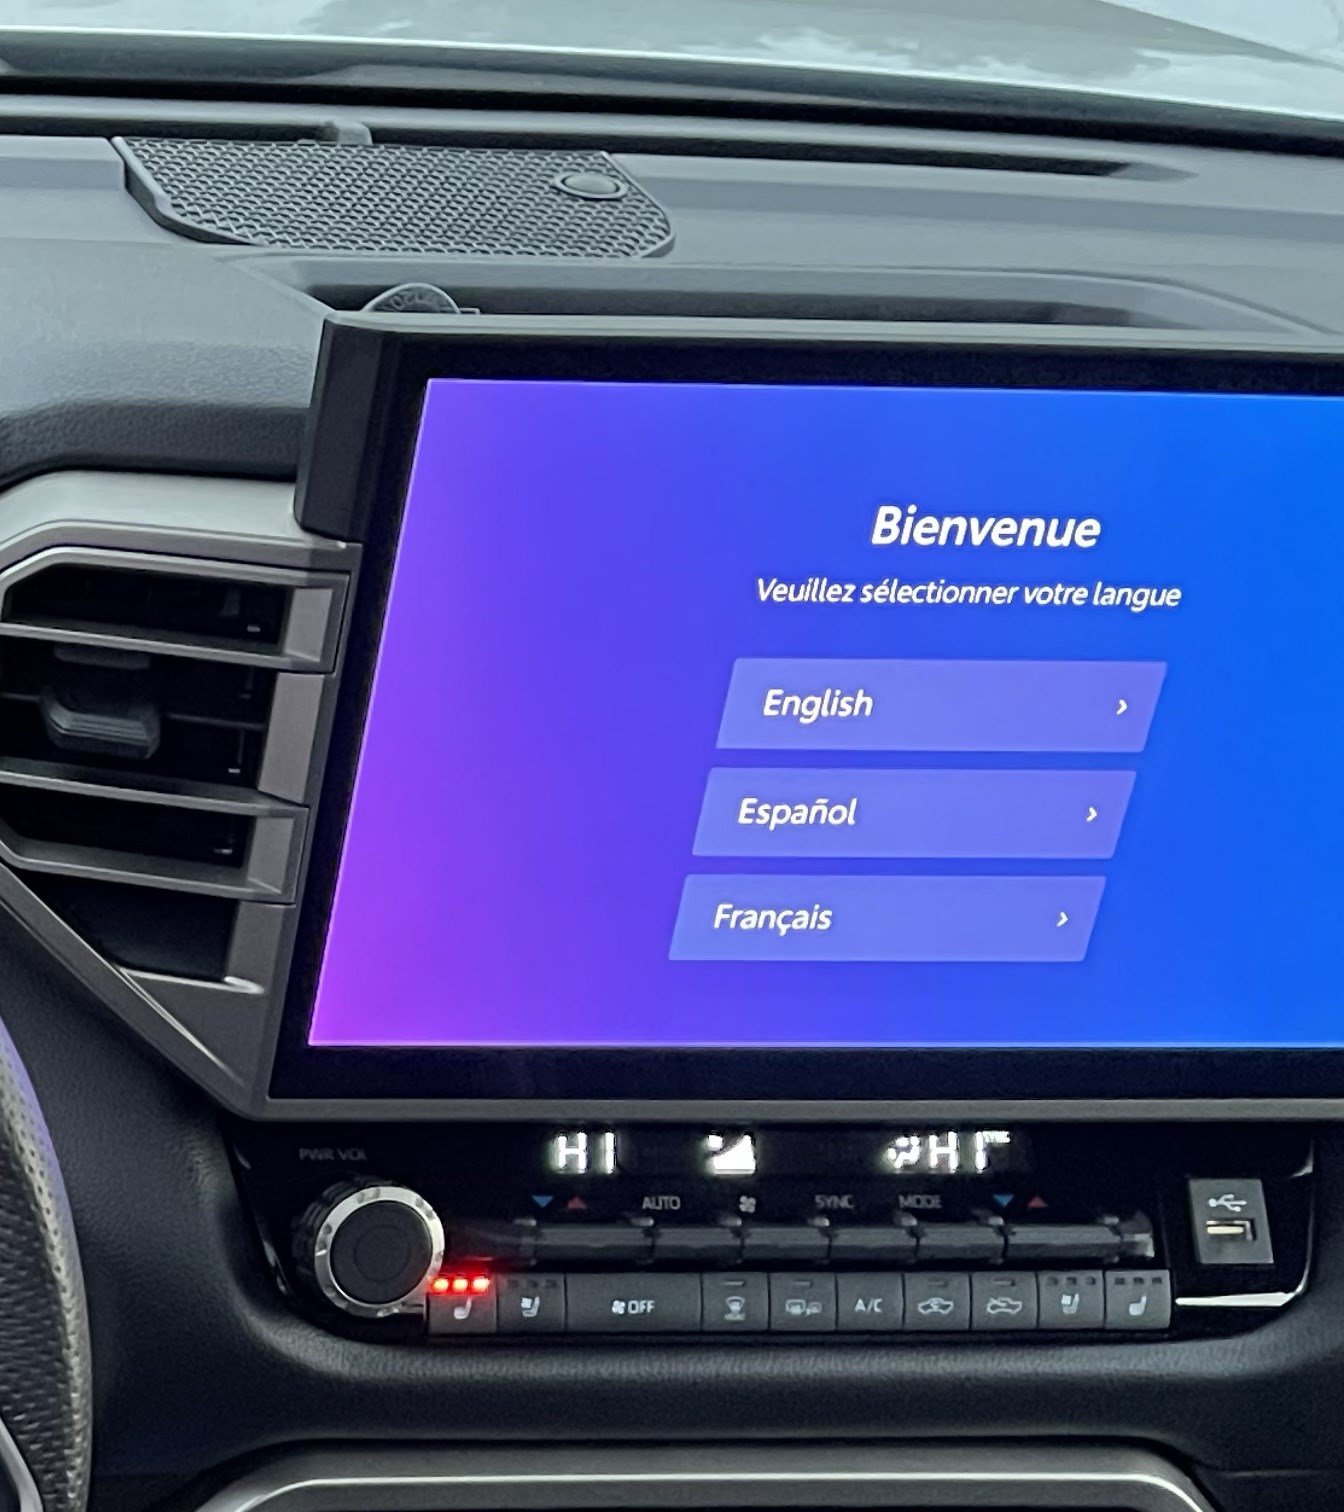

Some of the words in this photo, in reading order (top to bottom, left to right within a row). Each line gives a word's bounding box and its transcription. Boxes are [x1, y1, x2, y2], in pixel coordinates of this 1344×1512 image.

[872, 505, 1100, 547] Bienvenue
[757, 578, 855, 603] Veuillez
[860, 579, 1019, 604] sélectionner
[1025, 583, 1088, 605] votre
[1093, 582, 1181, 612] langue
[764, 689, 872, 724] English
[738, 798, 857, 830] Español
[714, 904, 832, 936] Français
[642, 1196, 680, 1210] AUTO
[815, 1195, 854, 1208] SYNC
[899, 1195, 941, 1208] MODE
[628, 1300, 654, 1314] OFF
[855, 1299, 882, 1312] A/C
